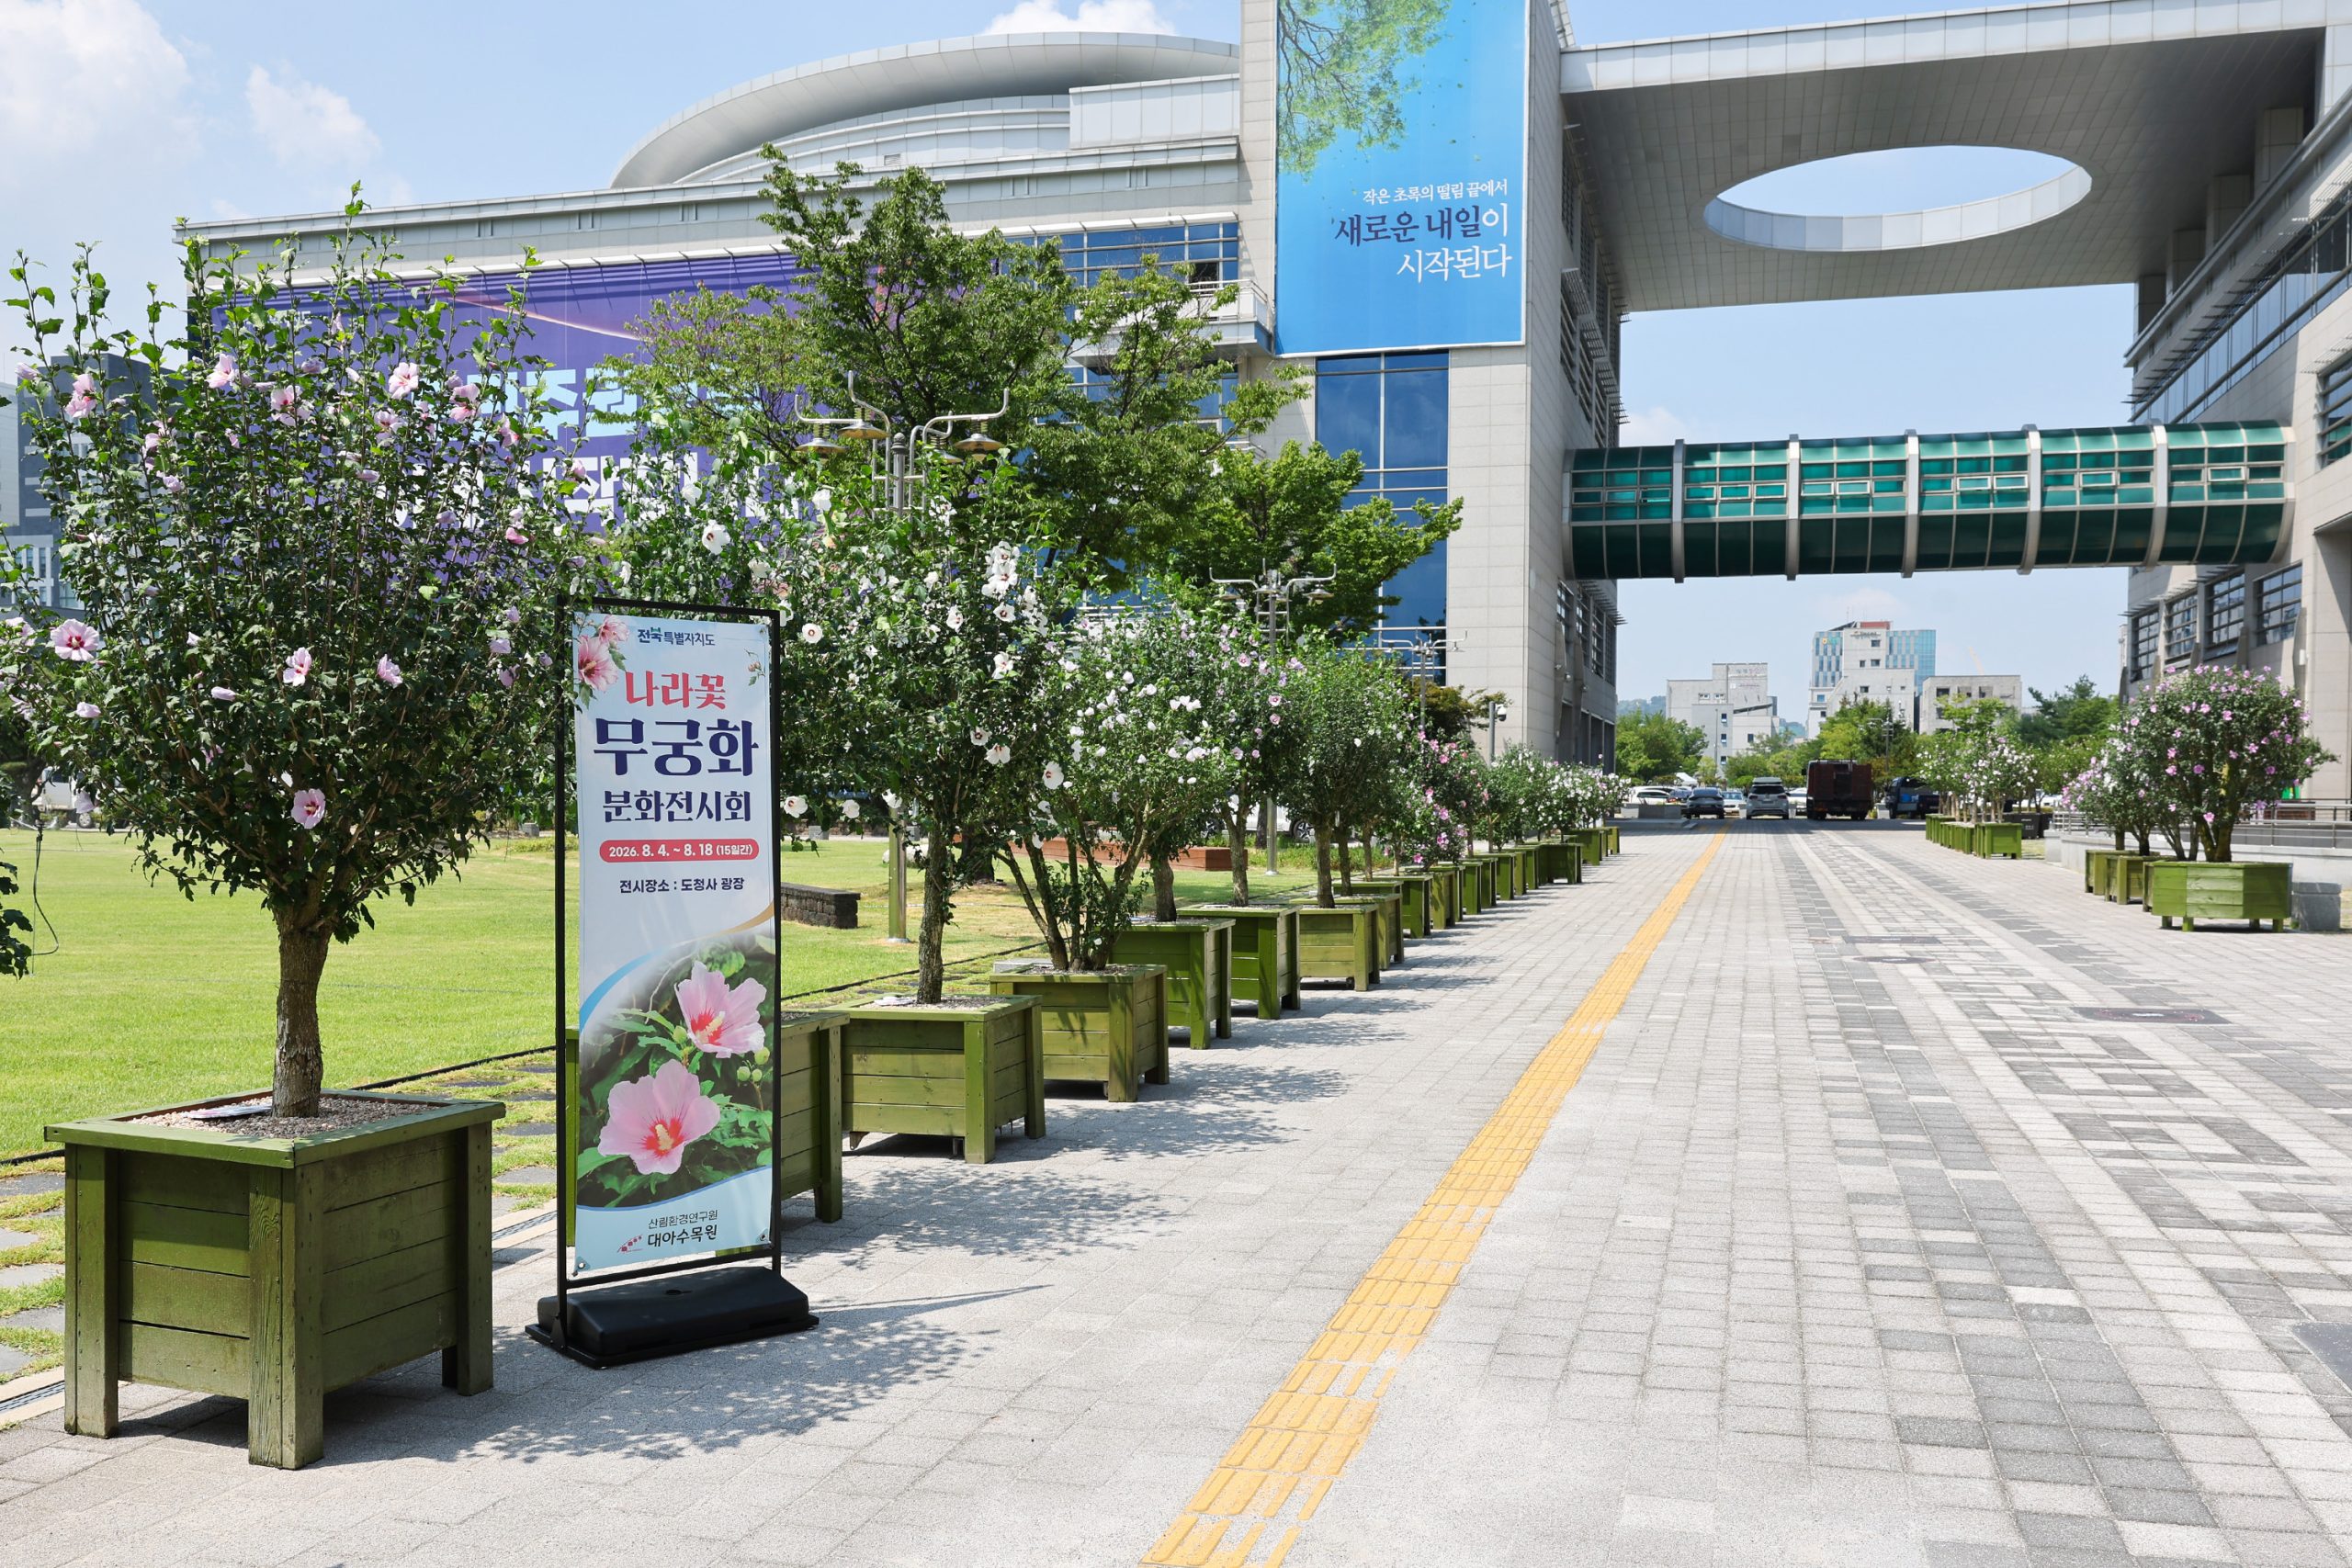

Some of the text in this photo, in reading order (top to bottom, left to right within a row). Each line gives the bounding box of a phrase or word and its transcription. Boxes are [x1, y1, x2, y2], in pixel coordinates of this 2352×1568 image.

[1363, 178, 1508, 206] 작은 초록의 떨림 끝에서
[1334, 202, 1508, 247] 새로운 내일이
[1396, 243, 1513, 284] 시작된다
[637, 626, 716, 647] 전북특별자치도
[625, 670, 727, 710] 나라꽃
[594, 717, 760, 777] 무궁화
[603, 789, 751, 823] 분화전시회
[609, 846, 639, 857] 2026.
[699, 843, 713, 855] 18
[716, 843, 753, 855] (15일간)
[619, 879, 670, 894] 전시장소
[681, 878, 718, 892] 도청사
[721, 877, 744, 890] 광장
[648, 1209, 718, 1229] 산림환경연구원
[648, 1224, 718, 1247] 대아수목원
